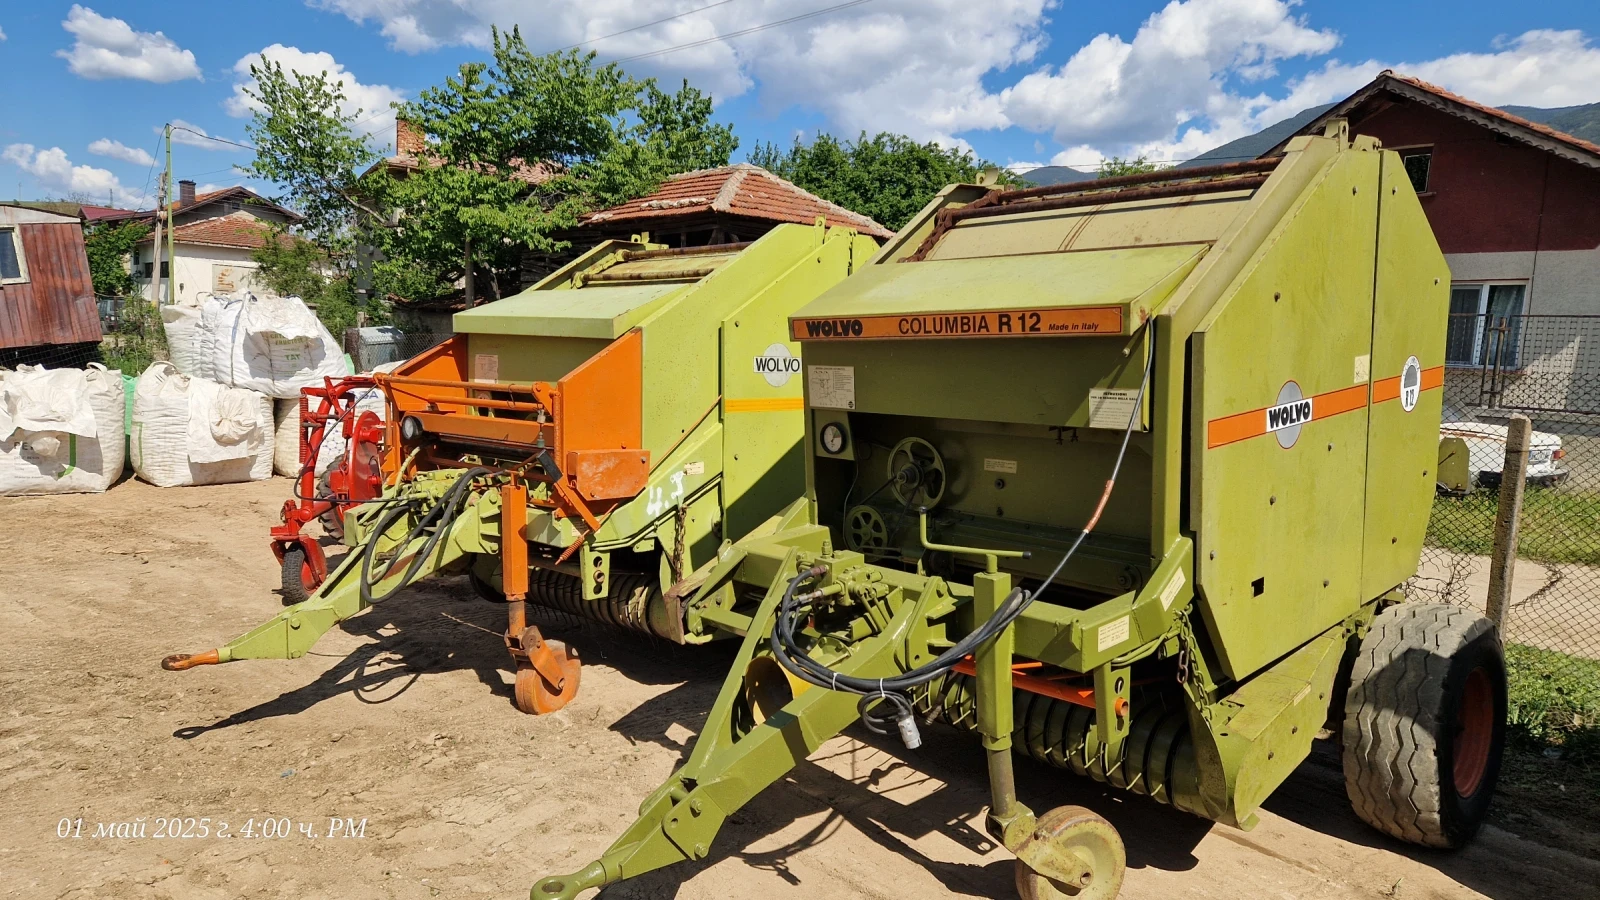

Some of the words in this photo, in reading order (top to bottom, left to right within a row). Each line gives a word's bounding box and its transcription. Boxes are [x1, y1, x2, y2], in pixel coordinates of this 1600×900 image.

[806, 319, 863, 337] WOLVO
[899, 315, 990, 335] COLUMBIA
[998, 313, 1012, 333] R
[1018, 312, 1041, 332] 12
[1048, 323, 1069, 331] Made
[1071, 322, 1079, 331] in
[755, 357, 800, 372] WOLVO
[1269, 401, 1310, 429] WOLVO
